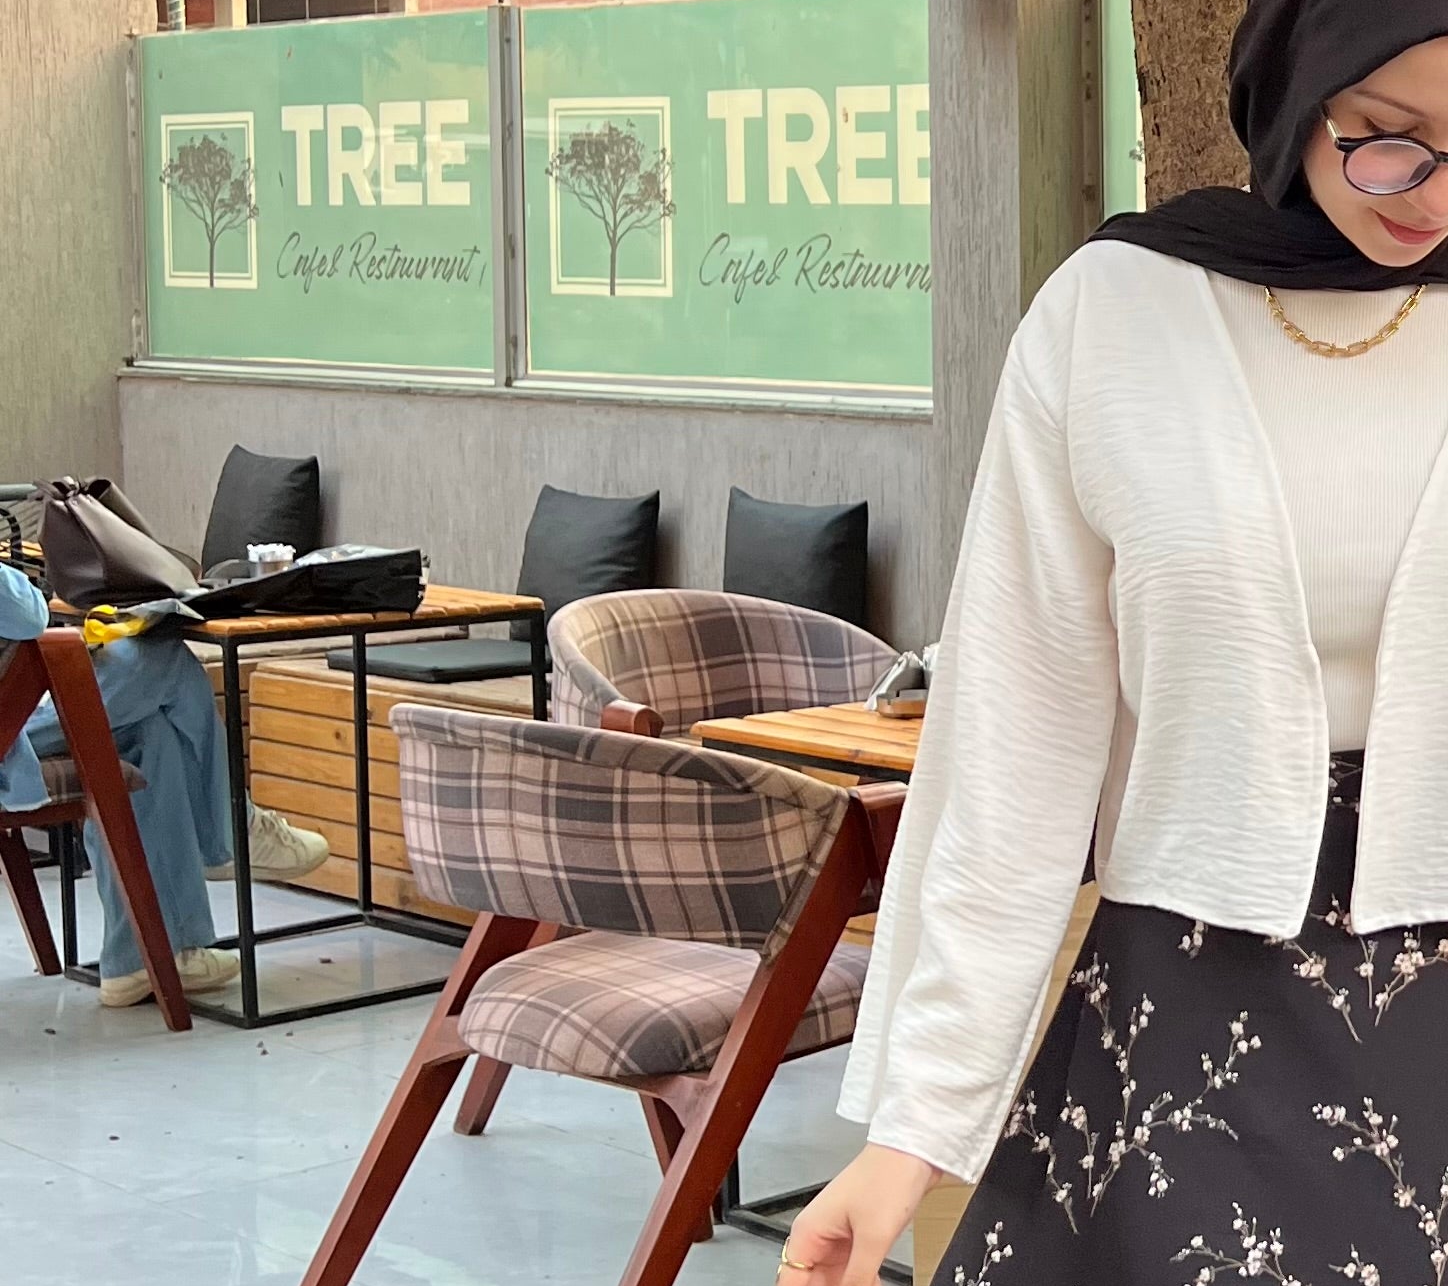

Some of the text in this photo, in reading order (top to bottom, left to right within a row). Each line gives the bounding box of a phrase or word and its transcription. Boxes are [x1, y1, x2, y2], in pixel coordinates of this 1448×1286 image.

[281, 99, 470, 206] TREE
[706, 83, 930, 205] TREE
[350, 231, 480, 284] Restaurant
[795, 233, 931, 293] Restaura
